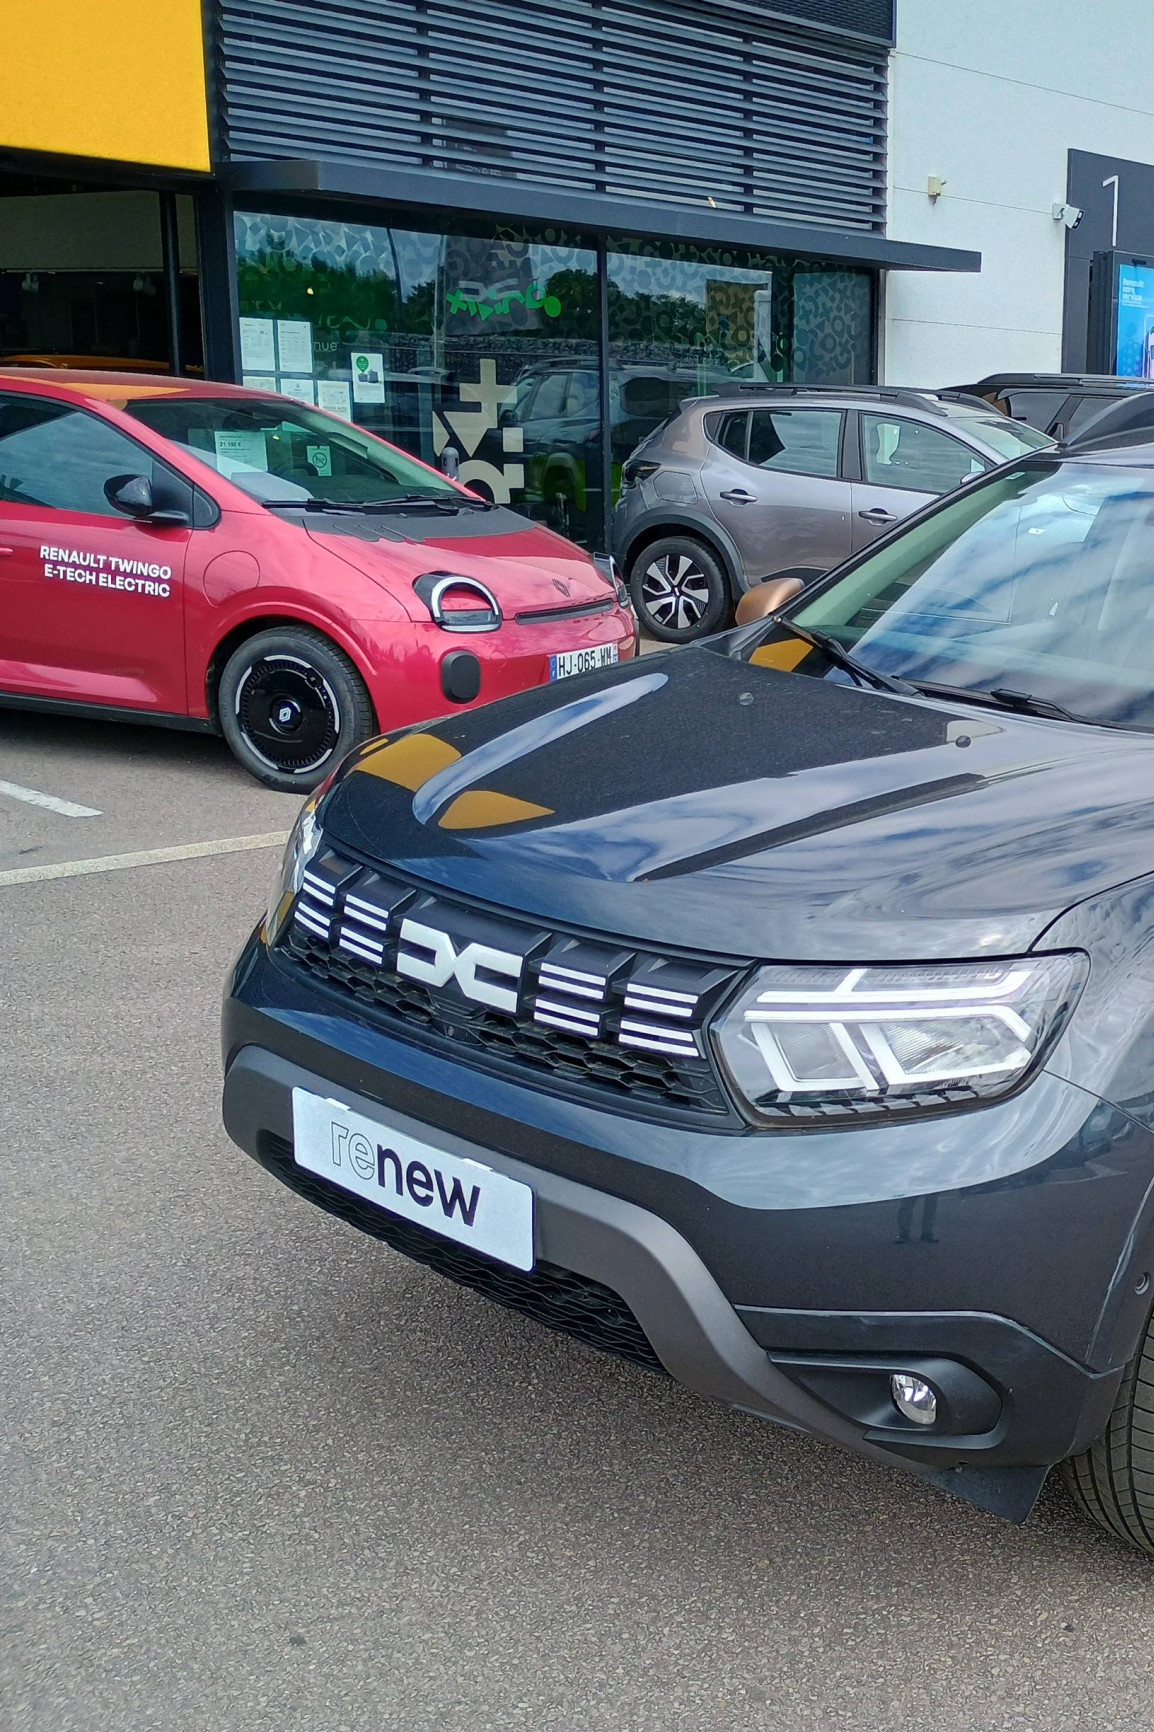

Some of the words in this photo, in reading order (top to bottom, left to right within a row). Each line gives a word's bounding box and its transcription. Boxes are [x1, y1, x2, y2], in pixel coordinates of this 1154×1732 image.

[1102, 175, 1119, 247] 1
[40, 545, 107, 568] RENAULT
[109, 556, 172, 580] TWINGO
[44, 563, 96, 585] E-TECH
[98, 572, 171, 598] ELECTRIC
[331, 1121, 481, 1228] renew
